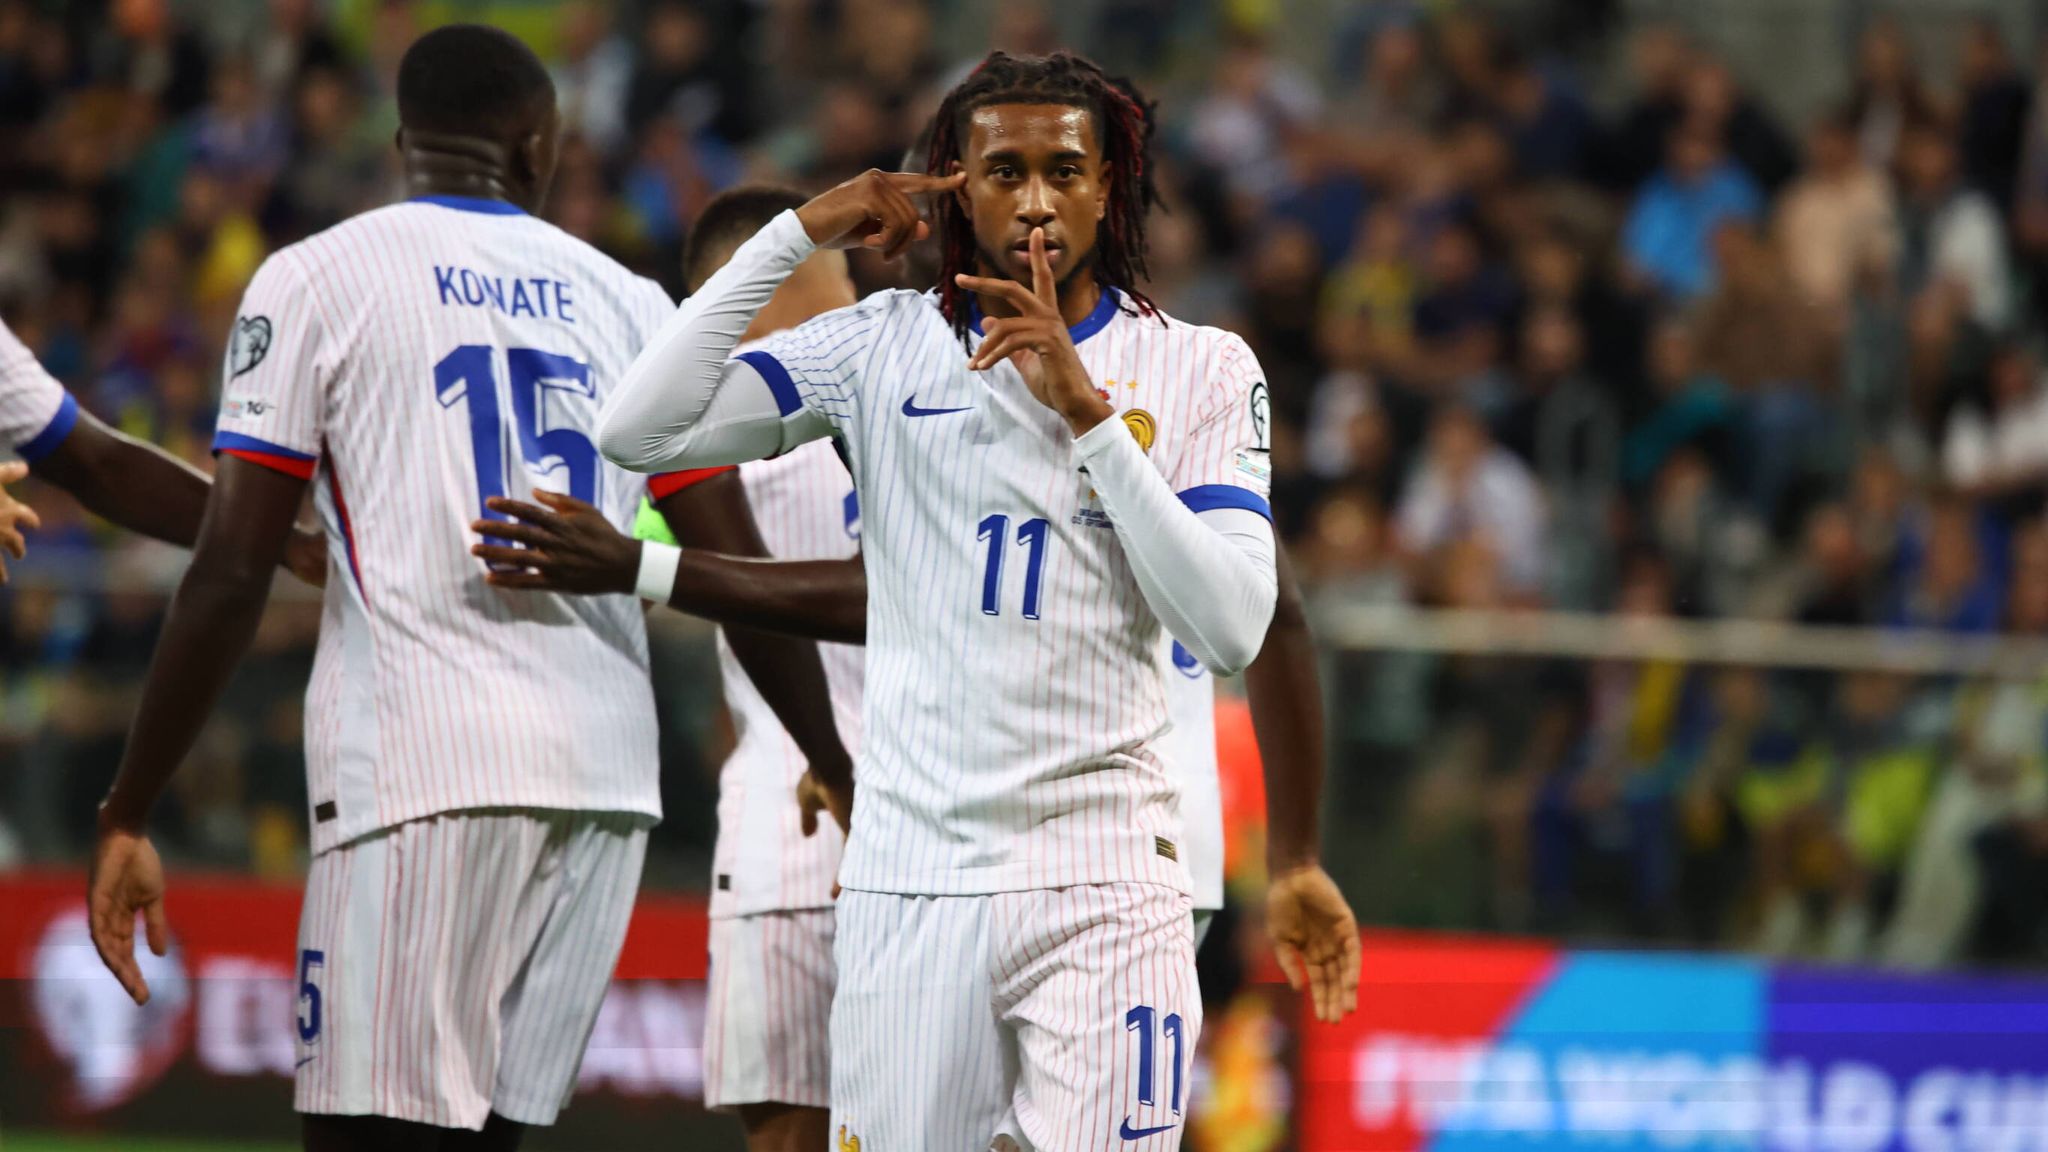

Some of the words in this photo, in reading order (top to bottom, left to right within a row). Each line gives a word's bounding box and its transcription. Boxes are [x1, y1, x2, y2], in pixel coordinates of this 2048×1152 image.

[433, 265, 575, 324] KONATE
[433, 344, 605, 574] 15
[977, 513, 1051, 620] 11
[1126, 1005, 1183, 1116] 11
[1352, 1034, 1549, 1136] FIFA
[1557, 1044, 1895, 1152] WORLD
